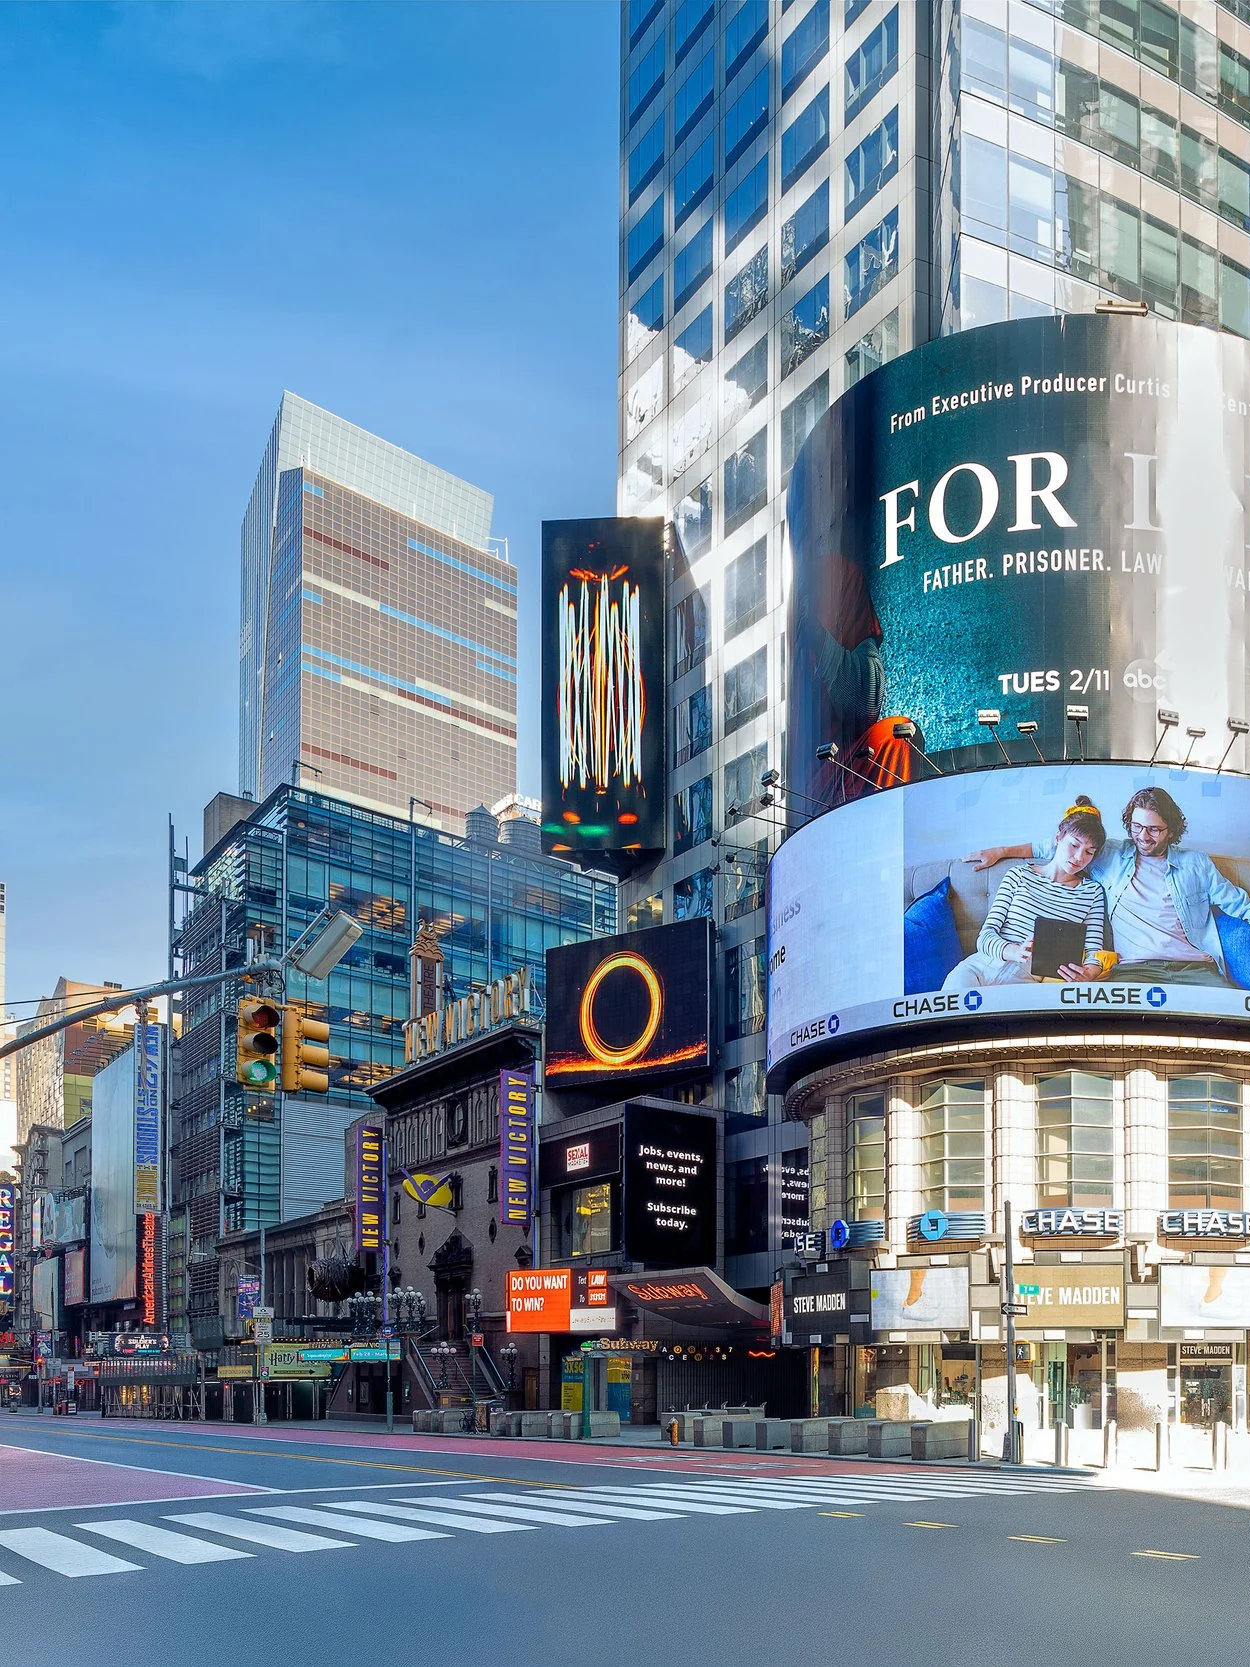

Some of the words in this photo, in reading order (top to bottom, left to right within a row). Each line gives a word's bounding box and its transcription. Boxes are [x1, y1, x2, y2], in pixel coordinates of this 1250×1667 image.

[890, 405, 926, 434] From
[932, 381, 1014, 416] Executive
[1021, 373, 1107, 396] Producer
[1114, 373, 1171, 398] Curtis
[878, 451, 1078, 570] FOR
[922, 558, 994, 594] FATHER.
[1002, 549, 1112, 577] PRISONER.
[998, 671, 1060, 695] TUES
[1069, 669, 1111, 693] 2/11
[1123, 669, 1168, 690] abc
[423, 963, 435, 1010] THEATRE
[1059, 986, 1142, 1006] CHASE
[404, 1008, 442, 1064] NEW
[445, 965, 531, 1045] VICTORY
[892, 994, 960, 1019] CHASE
[790, 1019, 826, 1048] CHASE
[508, 1076, 527, 1165] VICTORY
[639, 1145, 665, 1158] Jobs,
[666, 1150, 704, 1164] events,
[362, 1129, 379, 1203] VICTORY
[646, 1161, 677, 1173] news,
[678, 1163, 698, 1175] and
[656, 1176, 686, 1187] more!
[508, 1177, 527, 1220] NEW
[647, 1202, 697, 1216] Subscribe
[362, 1212, 379, 1248] NEW
[656, 1217, 689, 1231] today.
[1021, 1209, 1120, 1233] CHASE
[511, 1276, 523, 1291] DO
[525, 1276, 542, 1291] YOU
[543, 1275, 568, 1290] WANT
[627, 1280, 709, 1302] Subway
[511, 1298, 523, 1312] TO
[524, 1297, 545, 1311] WIN?
[793, 1296, 815, 1314] STEVE
[816, 1292, 846, 1312] MADDEN
[1058, 1286, 1120, 1306] MADDEN
[600, 1337, 659, 1352] Subway
[1182, 1345, 1202, 1355] STEVE
[1203, 1345, 1230, 1355] MADDEN
[269, 1351, 296, 1367] Harry
